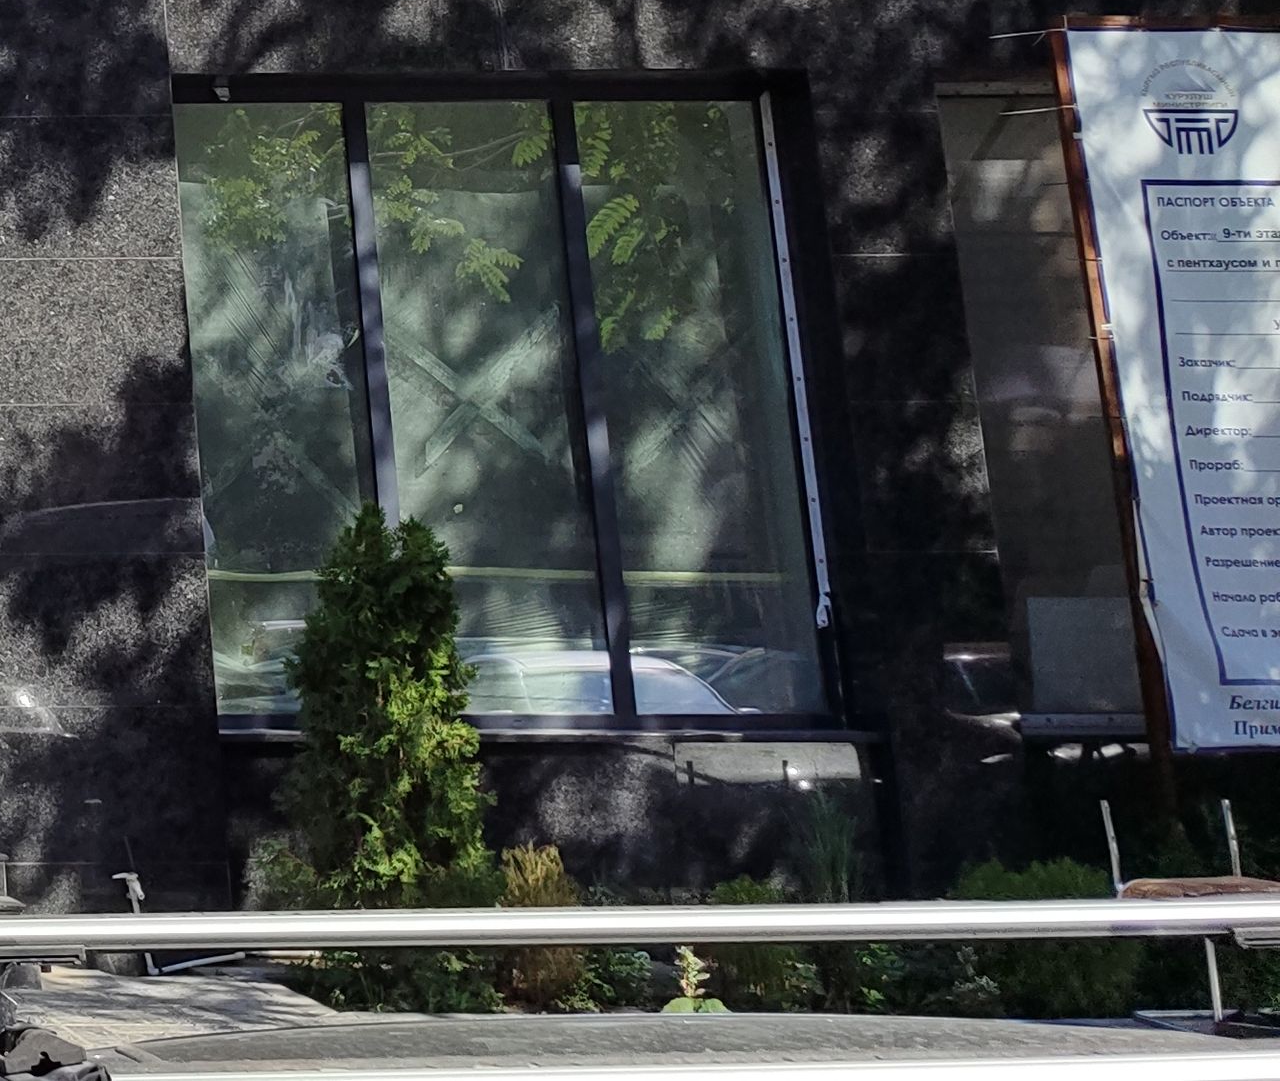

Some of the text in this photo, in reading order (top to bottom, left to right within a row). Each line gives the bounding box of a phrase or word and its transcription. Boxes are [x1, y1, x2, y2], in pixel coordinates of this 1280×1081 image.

[1157, 196, 1275, 207] ПАСПОРТ ОБЪЕКТА
[1223, 228, 1252, 239] 9-ти
[1255, 230, 1280, 239] эта
[1167, 259, 1175, 268] с
[1177, 259, 1257, 270] пентхаусом
[1262, 260, 1271, 268] и
[1185, 425, 1253, 438] Директор:
[1189, 459, 1244, 472] Прораб:
[1194, 493, 1264, 506] Проектная
[1200, 525, 1237, 538] Автор
[1204, 556, 1280, 569] Разрешение
[1212, 591, 1256, 603] Начало
[1221, 625, 1259, 638] Сдача
